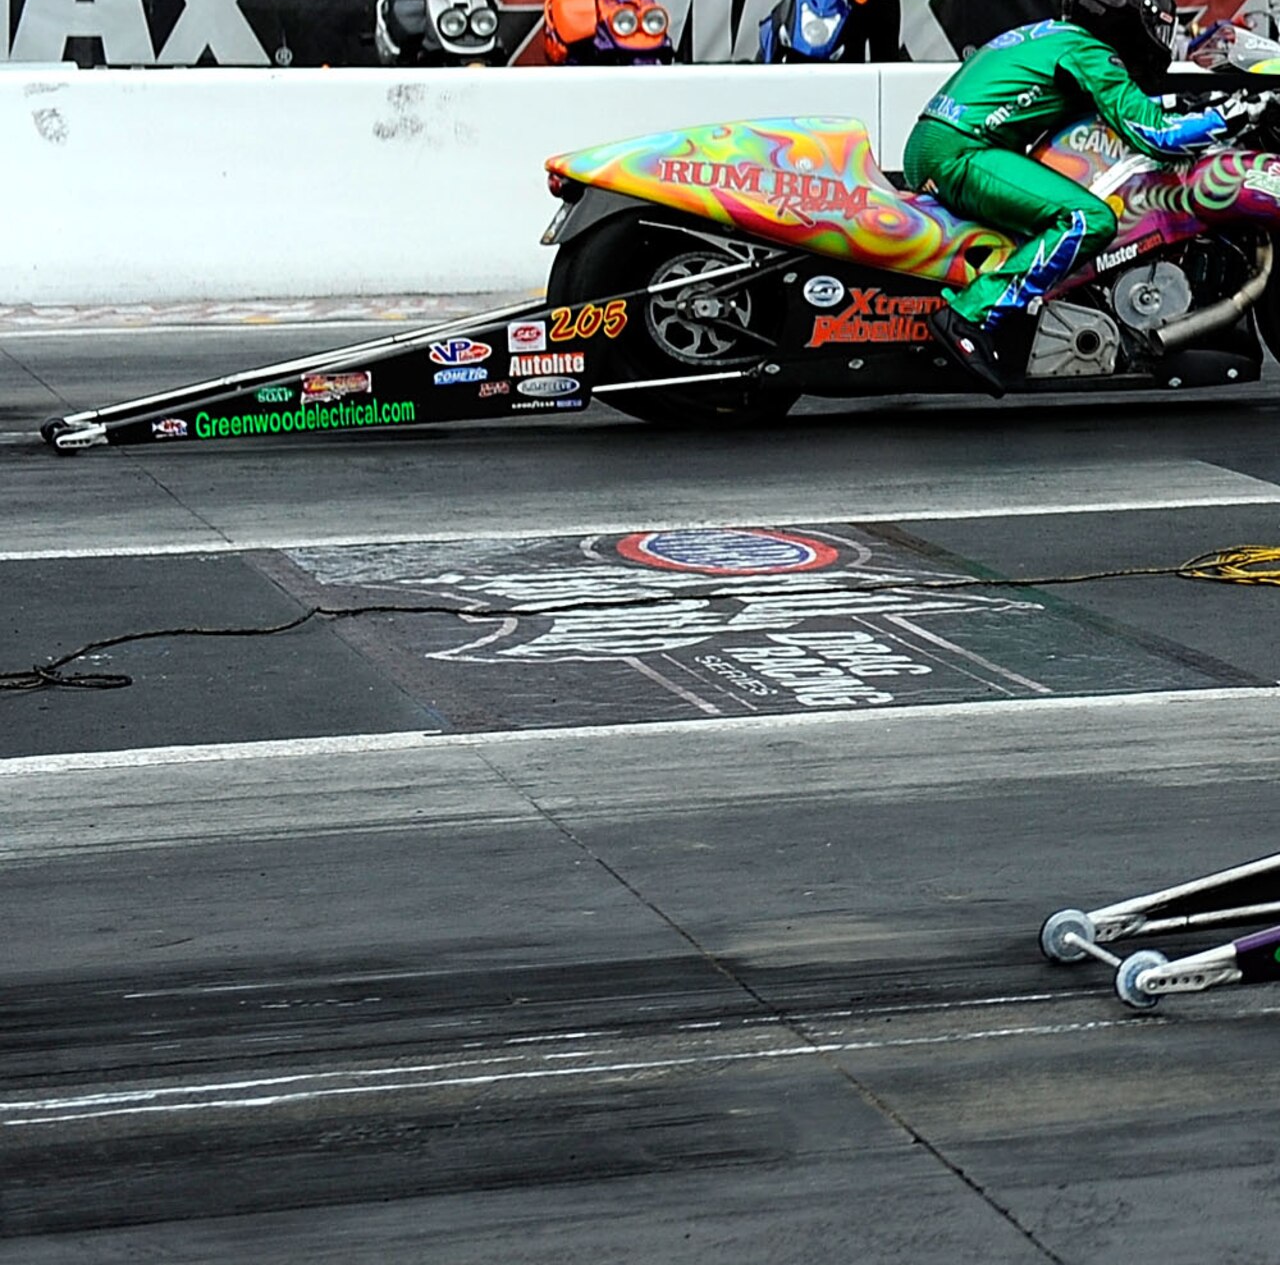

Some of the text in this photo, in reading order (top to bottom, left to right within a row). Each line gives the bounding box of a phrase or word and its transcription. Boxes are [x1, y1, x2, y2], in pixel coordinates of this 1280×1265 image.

[660, 159, 872, 211] RUM BUM
[849, 288, 947, 315] Xtrem
[549, 300, 627, 342] 205
[804, 315, 935, 347] Rebellio
[508, 353, 585, 377] Autolite
[195, 398, 416, 438] Greenwoodelectrical.com
